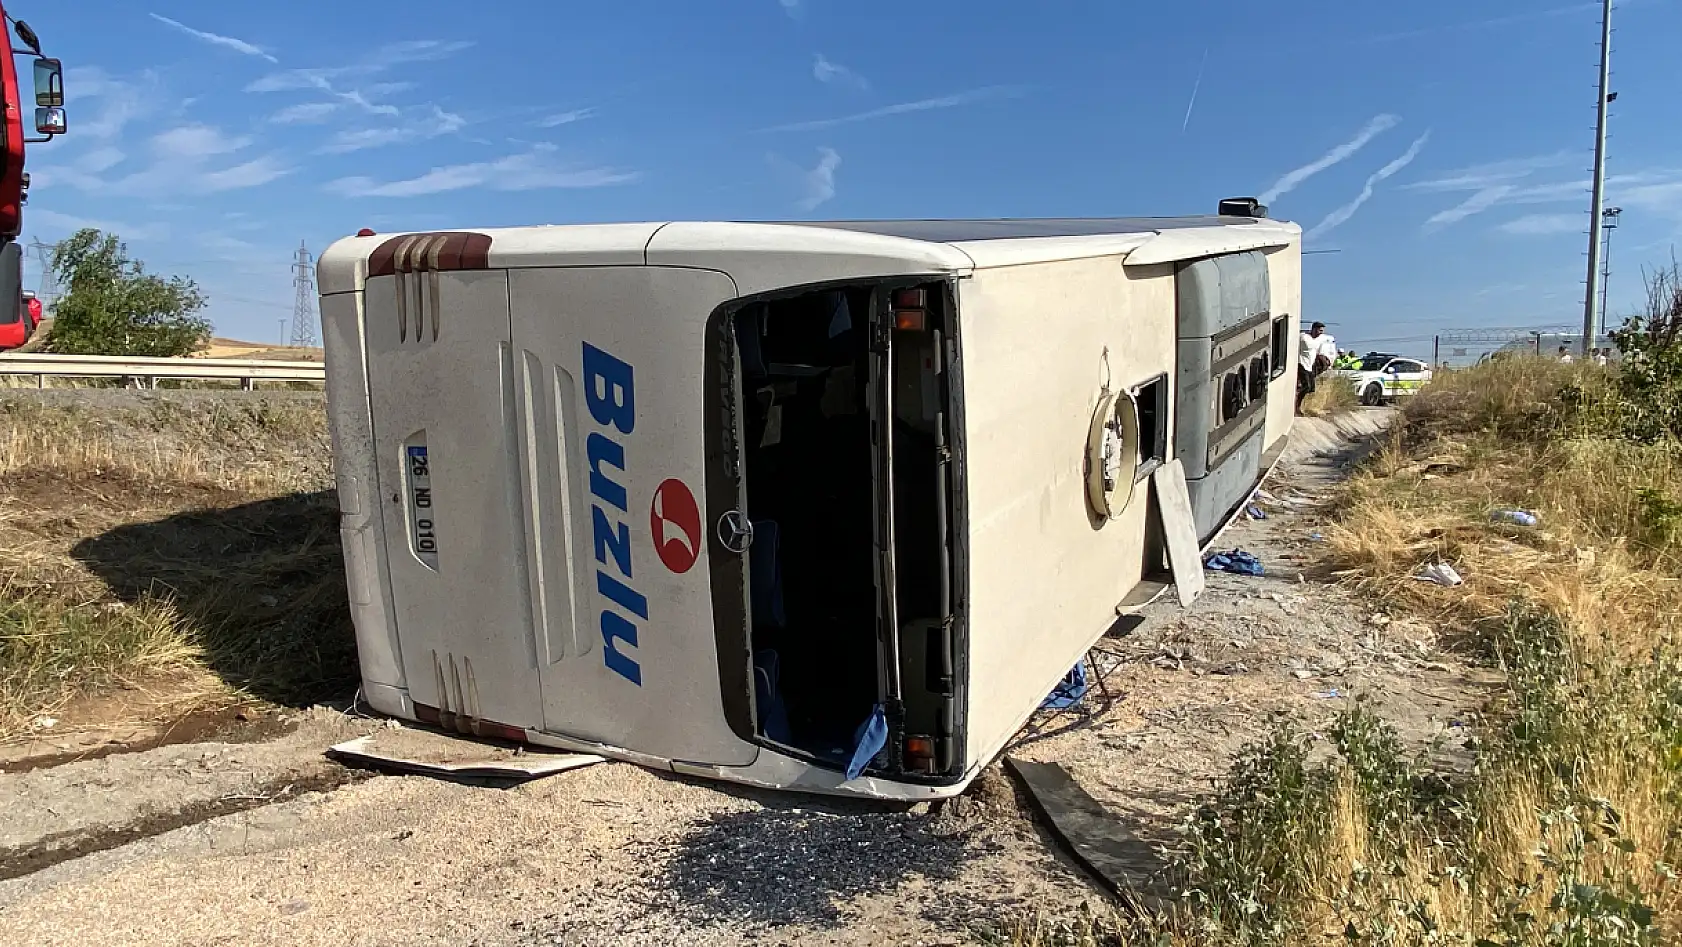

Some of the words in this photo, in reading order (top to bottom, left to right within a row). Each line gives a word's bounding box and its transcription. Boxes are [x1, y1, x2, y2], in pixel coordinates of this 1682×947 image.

[412, 456, 428, 476] 26
[415, 488, 431, 509] ND
[582, 341, 649, 687] Buzlu
[419, 519, 435, 550] 010
